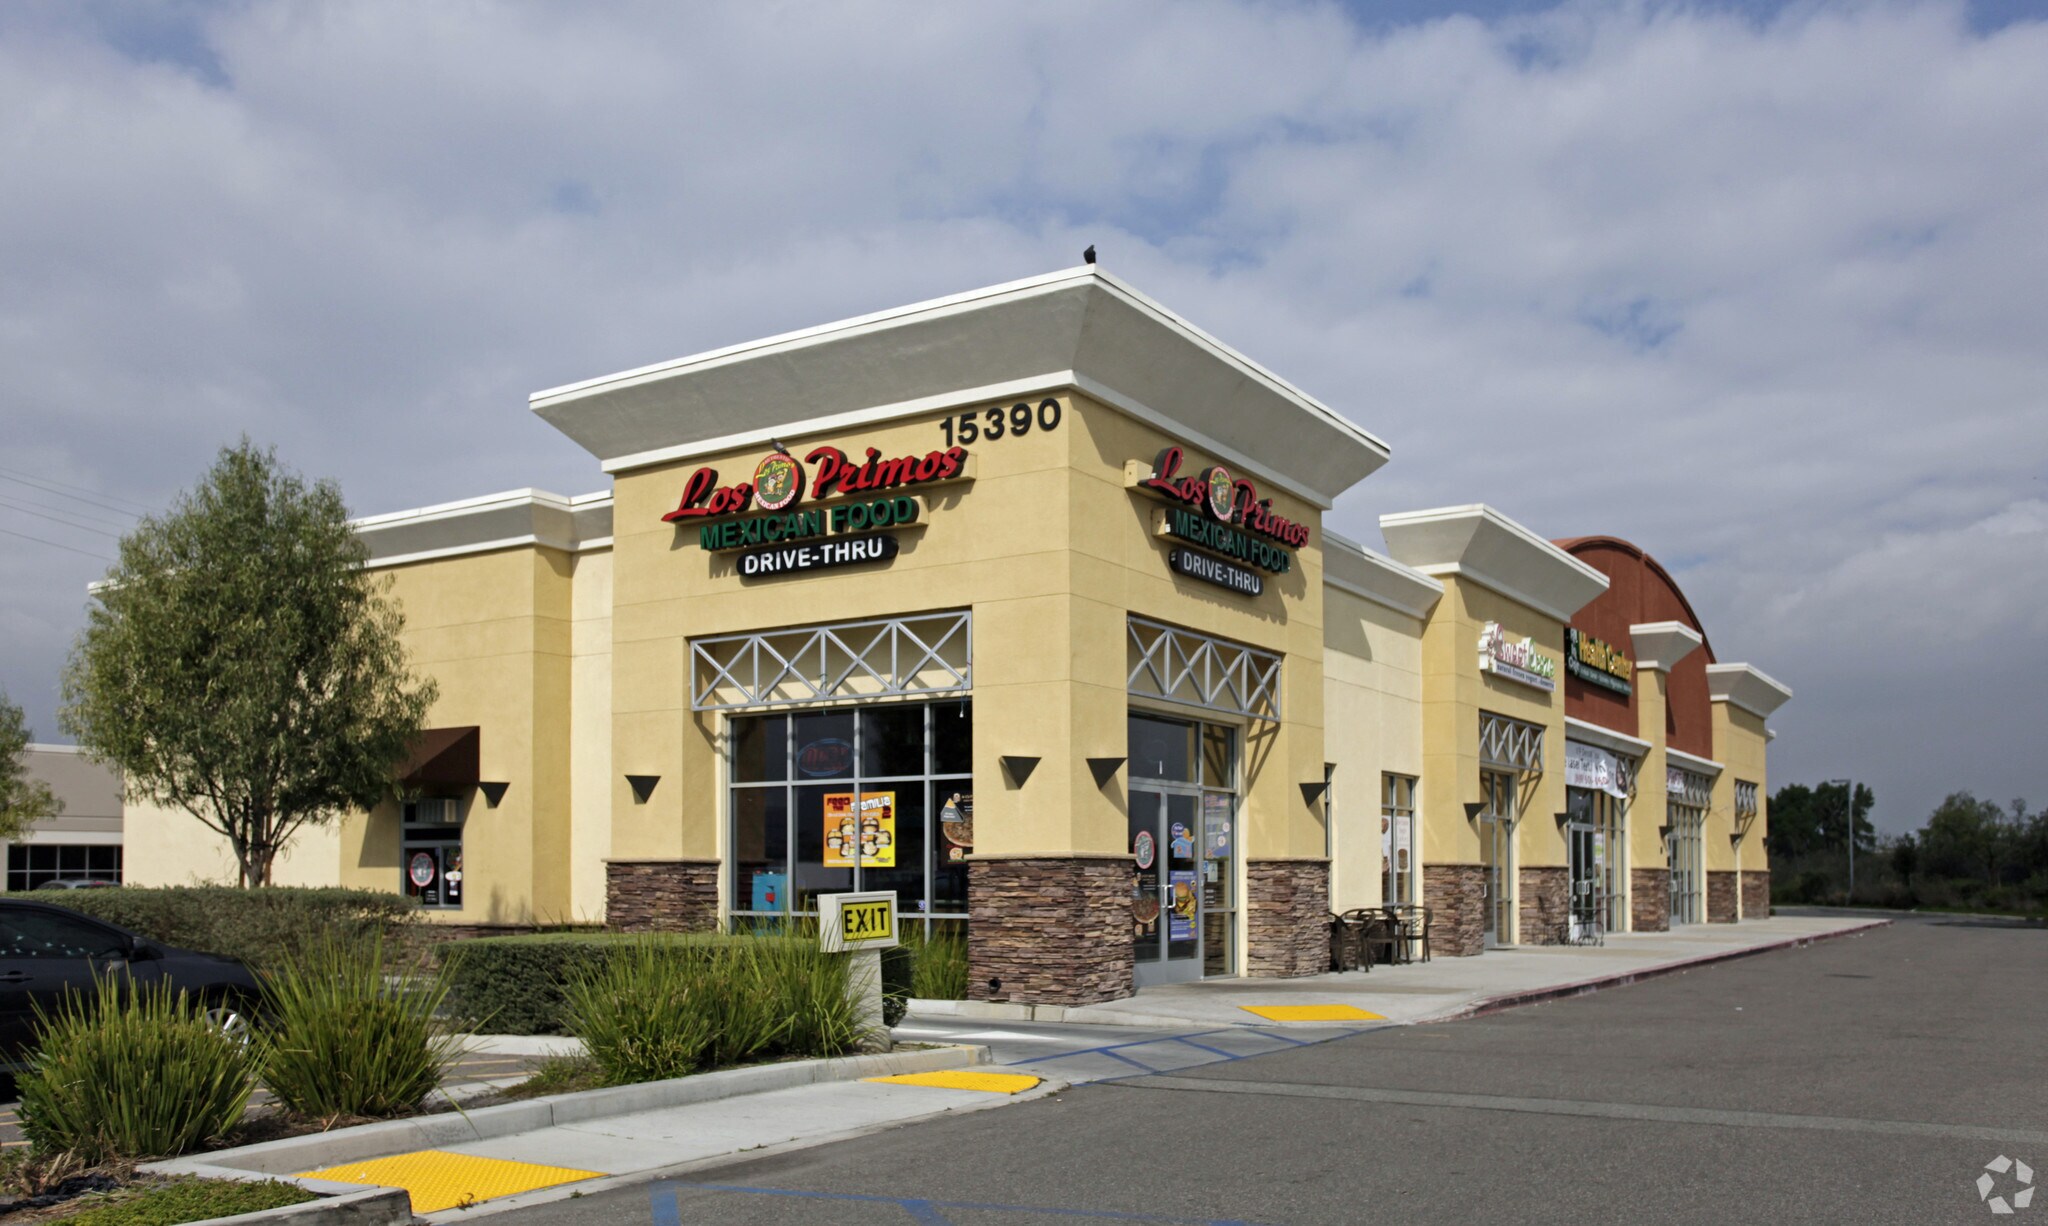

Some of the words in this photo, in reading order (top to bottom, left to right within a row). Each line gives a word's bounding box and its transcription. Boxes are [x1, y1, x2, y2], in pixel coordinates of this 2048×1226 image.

[940, 398, 1061, 447] 15390
[661, 467, 754, 522] Los
[805, 446, 969, 499] Primos
[1149, 447, 1205, 504] Los
[1236, 479, 1310, 548] Primos
[700, 509, 823, 550] MEXICAN
[831, 496, 915, 532] FOOD
[1175, 509, 1248, 559] MEXICAN
[1251, 539, 1290, 574] FOOD
[744, 537, 883, 574] DRIVE-THRU
[1183, 551, 1260, 594] DRIVE-THRU
[1579, 631, 1606, 670] Health
[844, 907, 887, 933] EXIT
